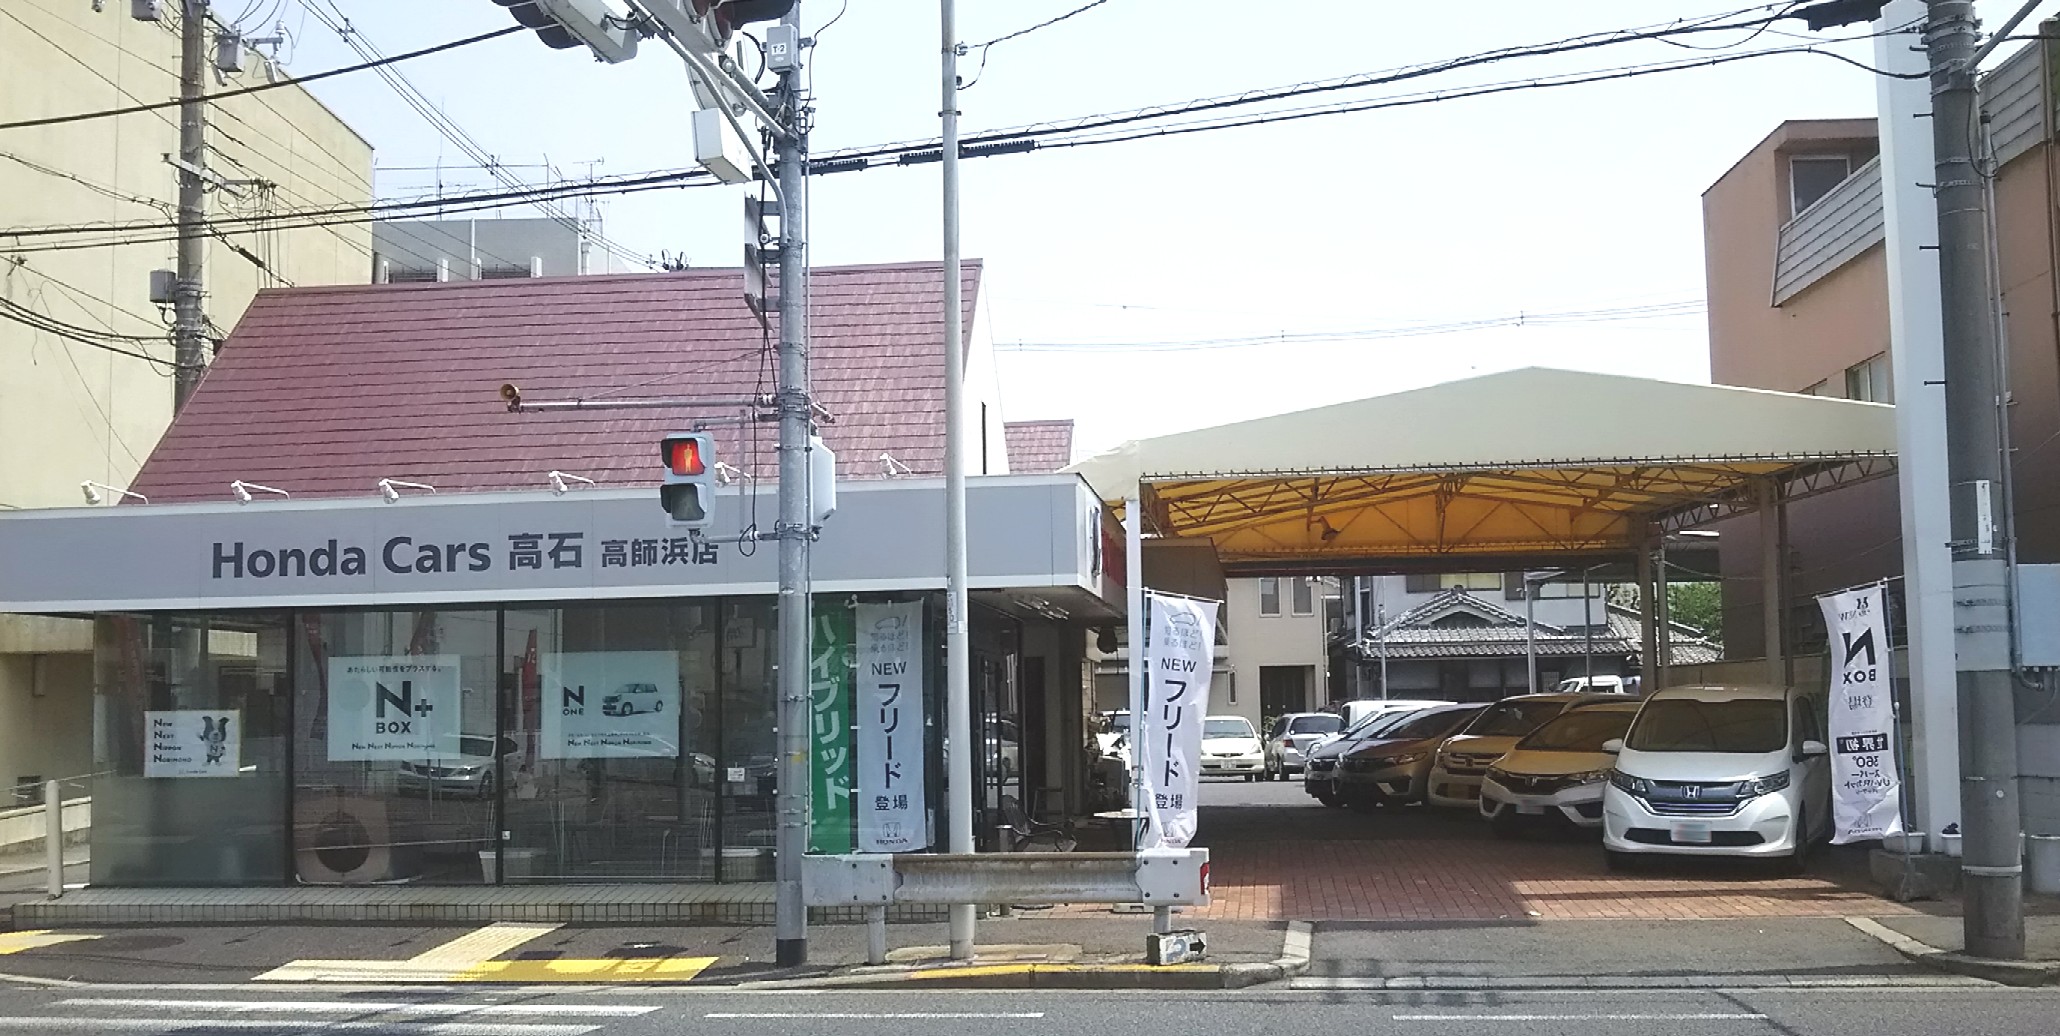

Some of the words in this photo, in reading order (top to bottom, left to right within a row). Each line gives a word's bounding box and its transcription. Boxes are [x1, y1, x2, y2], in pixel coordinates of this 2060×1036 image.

[212, 539, 367, 579] Honda
[382, 536, 491, 575] Cars
[508, 532, 584, 570] 高石
[601, 536, 719, 567] 高師浜店
[871, 661, 907, 676] NEW
[1161, 657, 1197, 673] NEW
[563, 685, 585, 707] N
[562, 708, 585, 716] ONE
[376, 721, 412, 735] BOX
[878, 683, 902, 790] フリード
[1163, 679, 1187, 787] フリード
[875, 794, 908, 812] 登場
[1155, 793, 1183, 810] 登場
